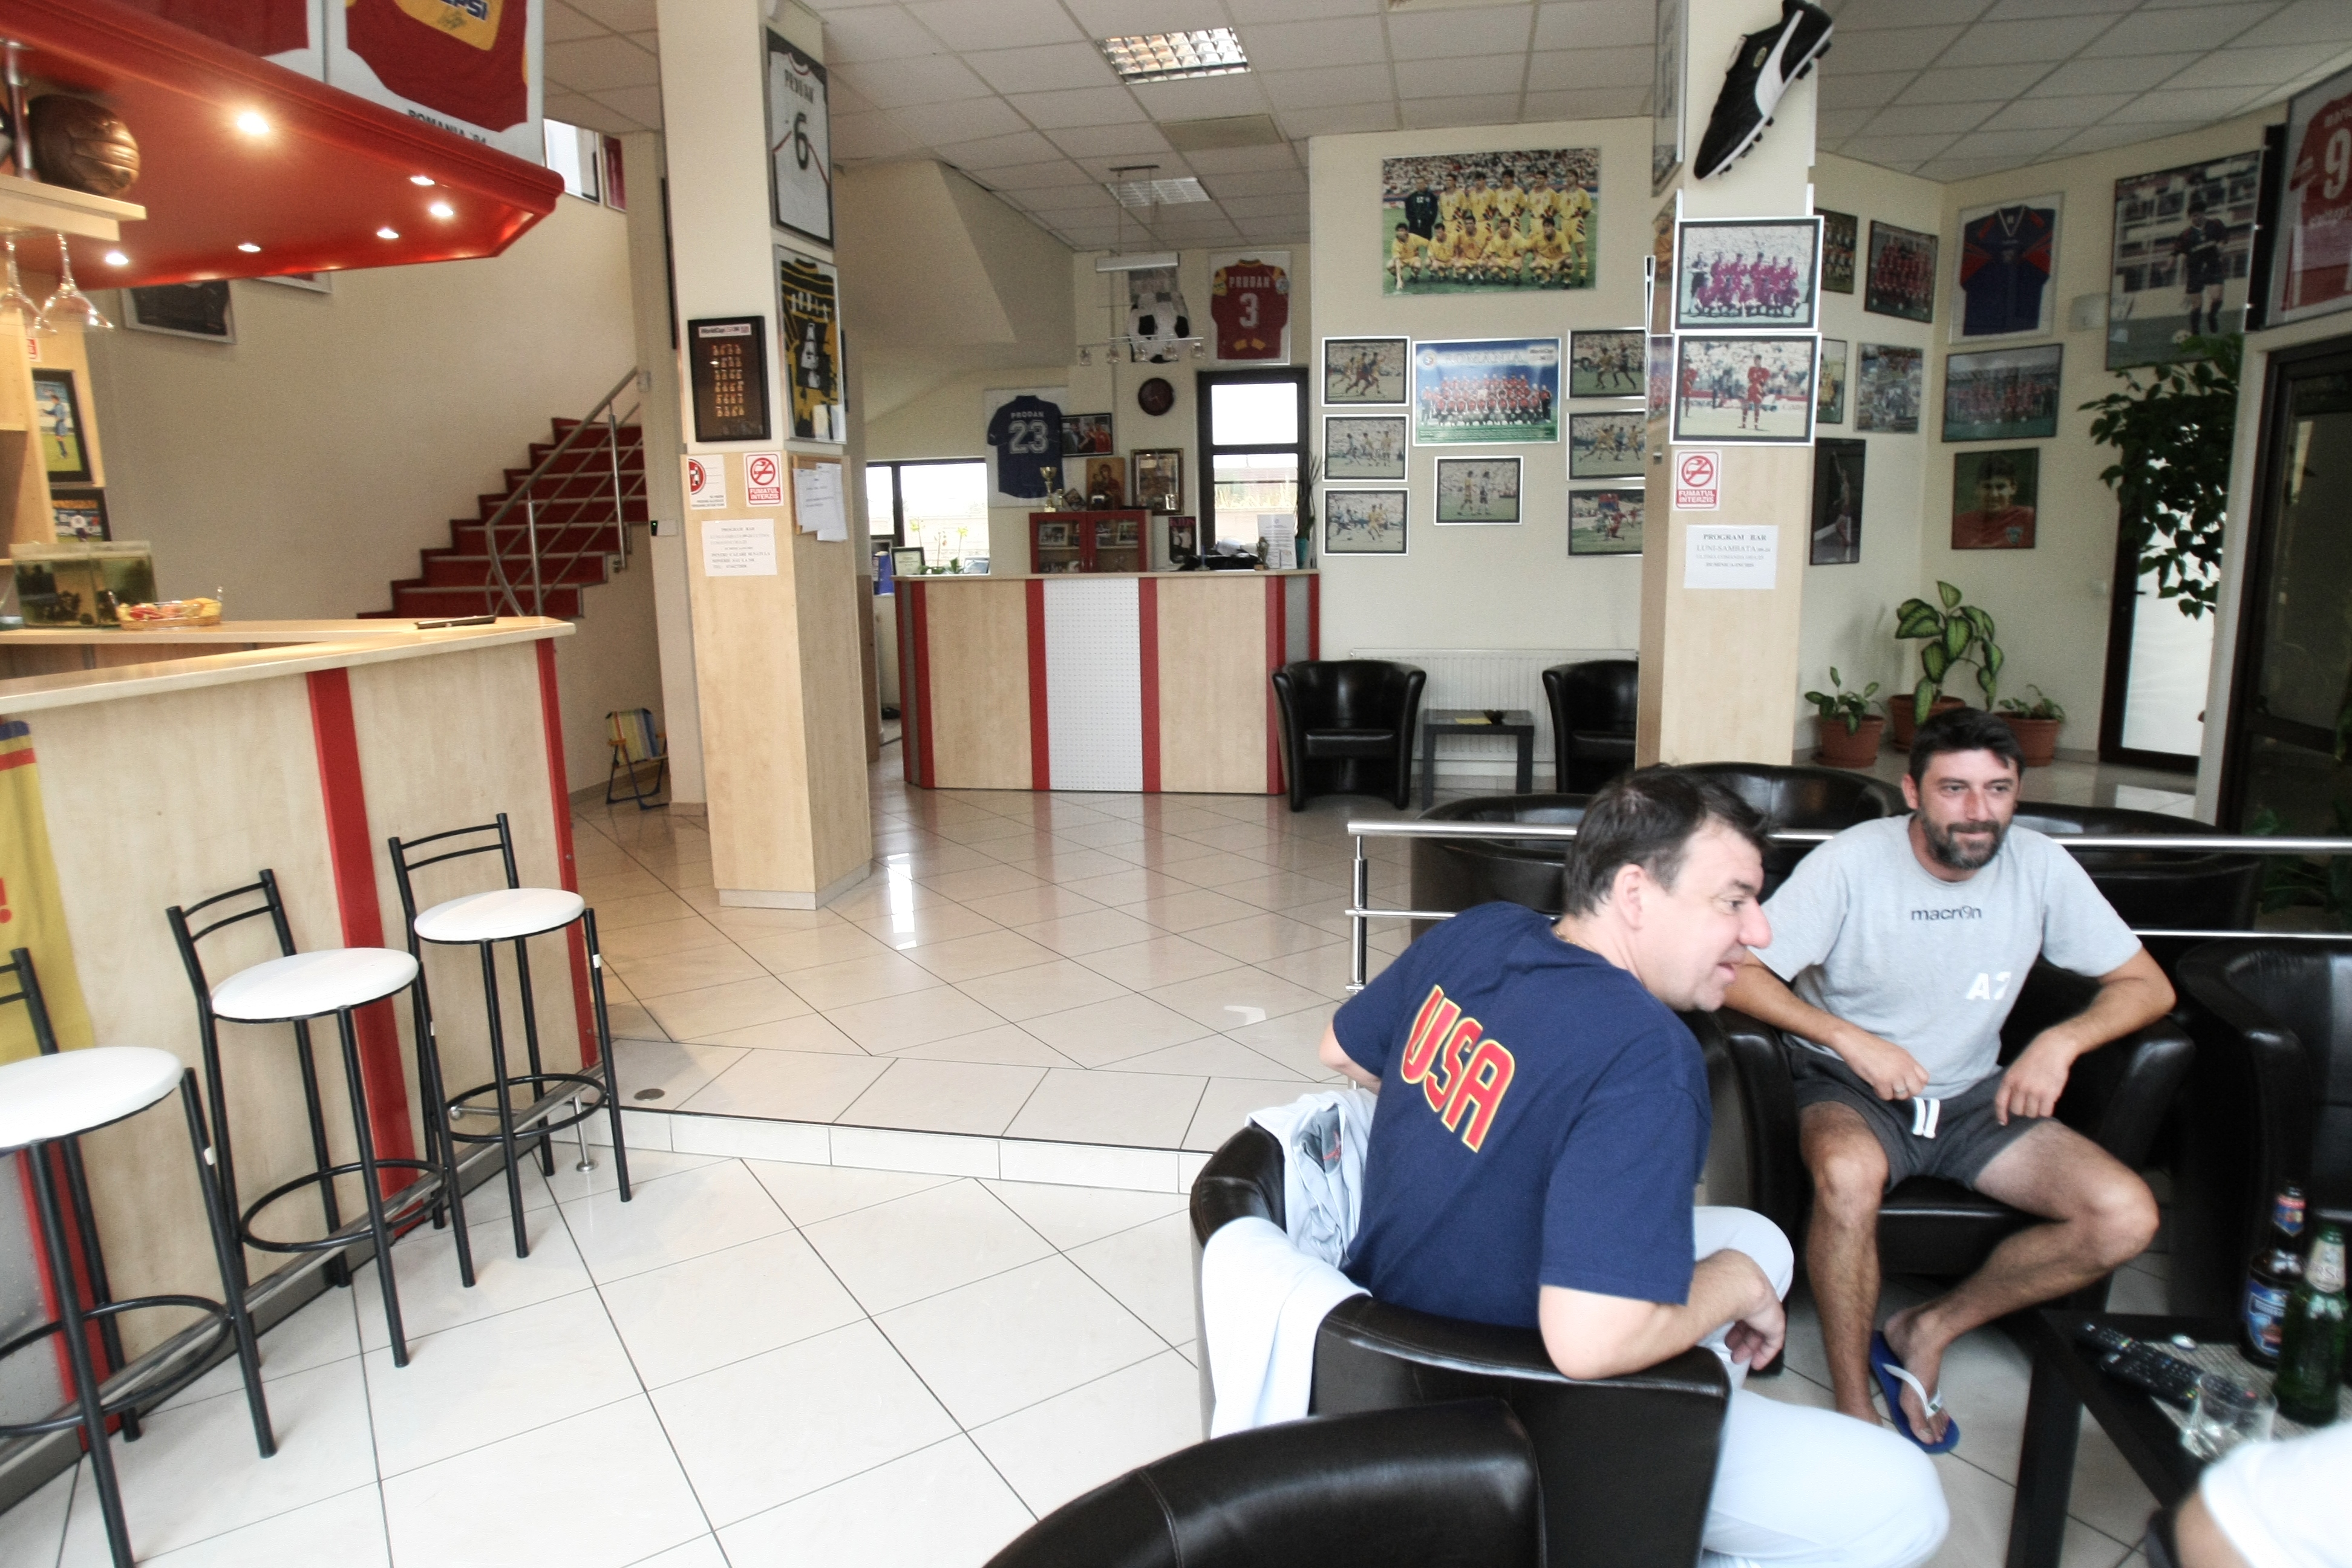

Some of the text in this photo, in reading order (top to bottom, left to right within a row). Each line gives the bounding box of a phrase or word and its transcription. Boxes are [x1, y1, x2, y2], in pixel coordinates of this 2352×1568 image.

[794, 111, 809, 170] 6
[2324, 128, 2351, 200] 9
[1239, 293, 1259, 328] 3
[1008, 419, 1049, 454] 23
[1910, 905, 1982, 921] macron
[1401, 984, 1515, 1153] USA
